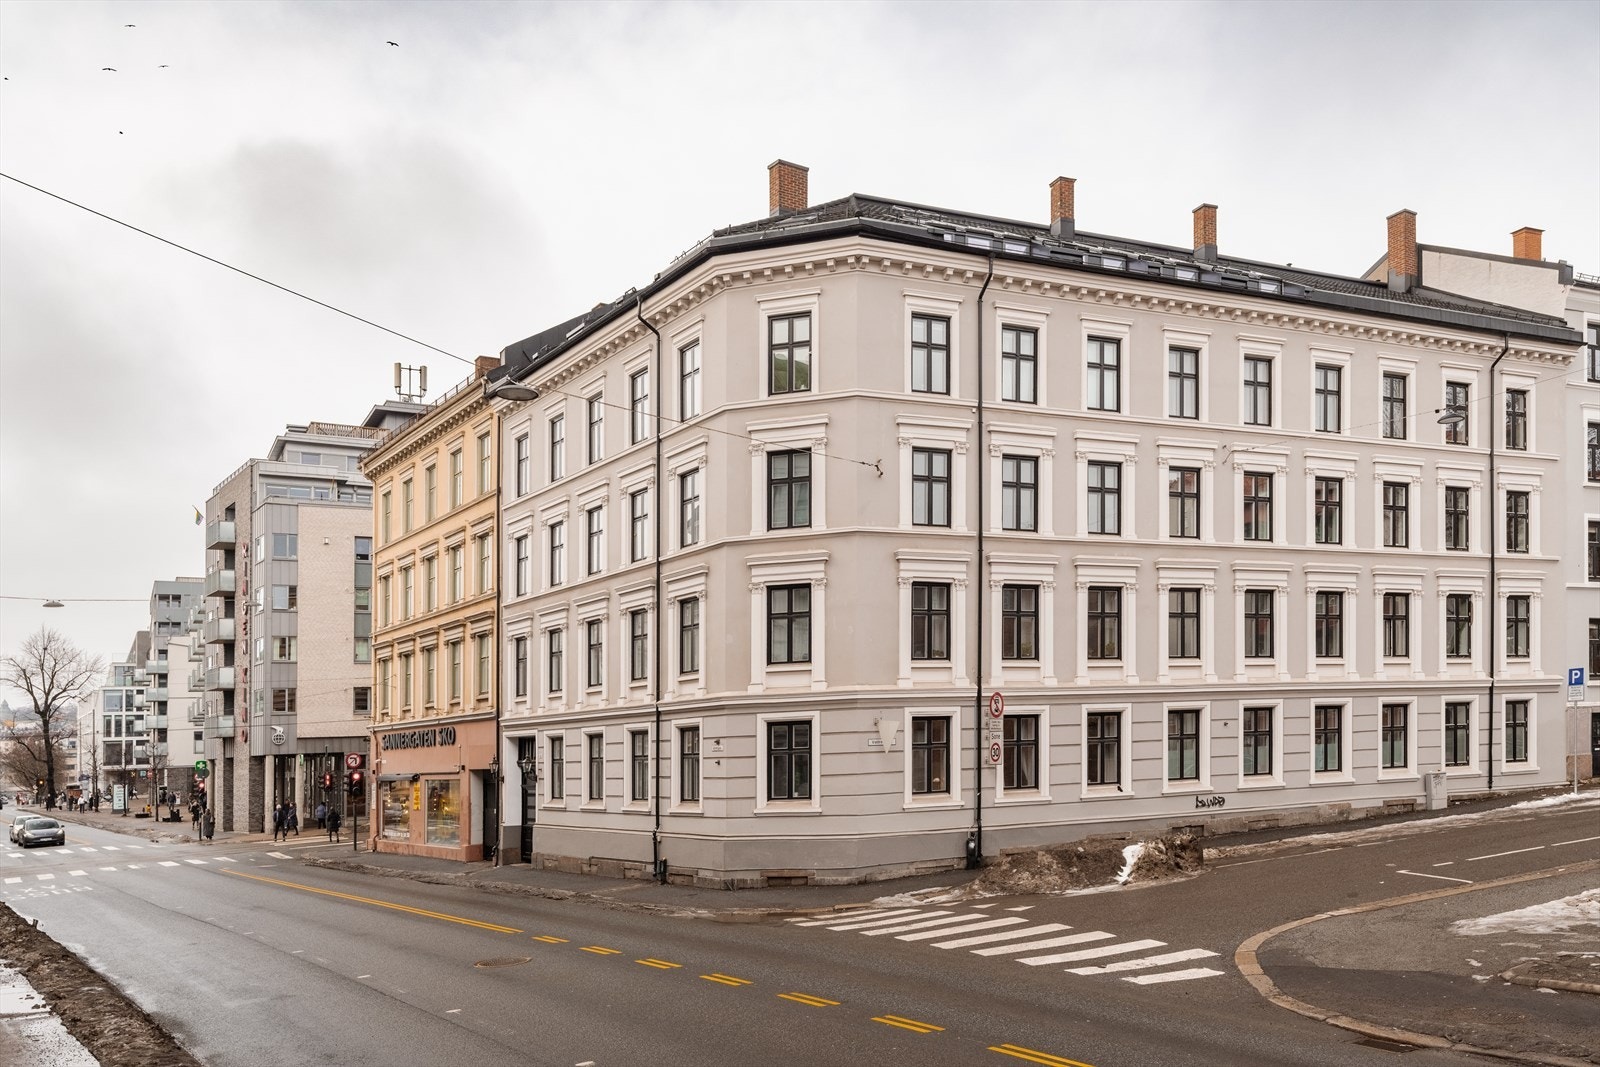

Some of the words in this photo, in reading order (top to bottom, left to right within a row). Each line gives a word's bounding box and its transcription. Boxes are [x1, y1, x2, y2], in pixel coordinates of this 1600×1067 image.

[1571, 670, 1581, 684] P
[382, 729, 436, 751] SANNERGATEN
[438, 726, 456, 748] SKO
[992, 747, 999, 757] 30
